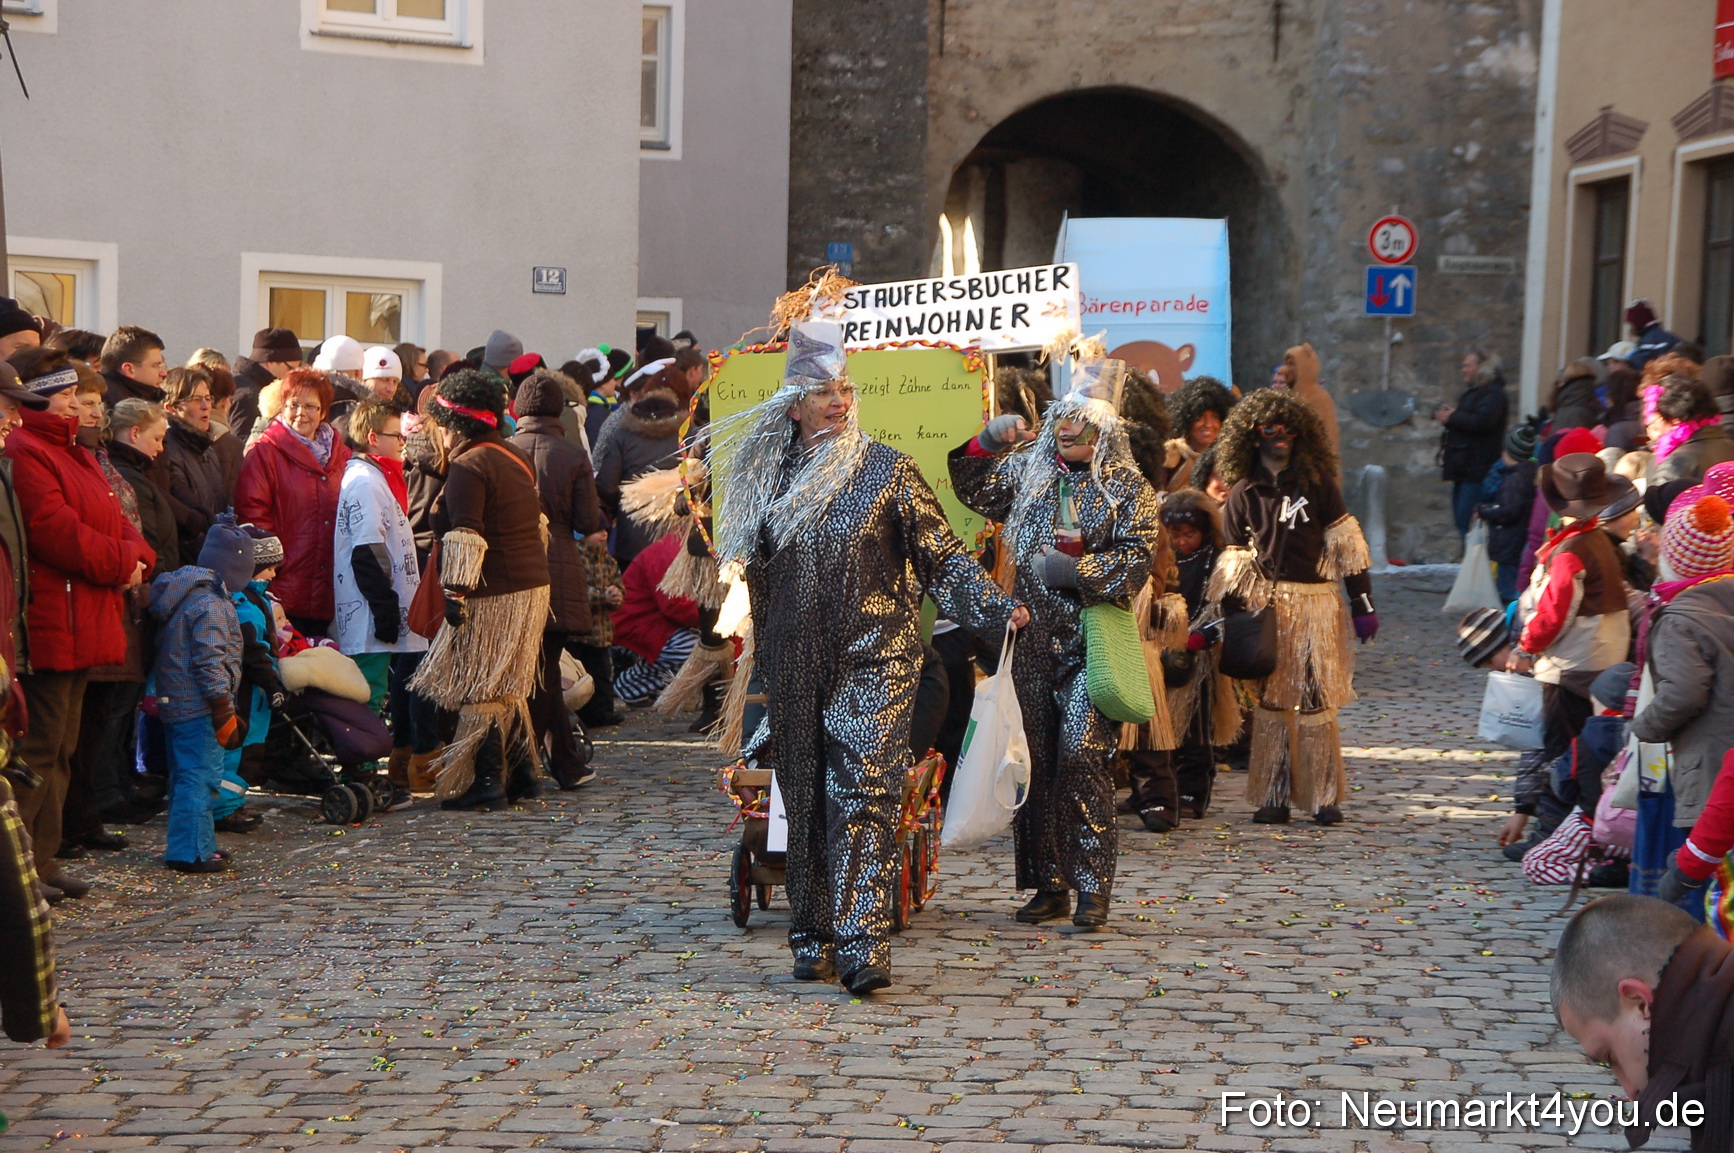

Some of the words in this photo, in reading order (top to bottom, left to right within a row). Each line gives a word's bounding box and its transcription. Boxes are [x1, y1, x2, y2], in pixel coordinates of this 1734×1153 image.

[1381, 230, 1391, 250] 3
[1393, 239, 1405, 250] m
[540, 269, 561, 283] 12
[843, 265, 1070, 310] STAUFERSBUCHER
[1079, 291, 1210, 317] Bärenparade
[841, 303, 1031, 344] REINWOHNER
[716, 379, 748, 401] Ein
[861, 376, 890, 397] zeigt
[898, 374, 932, 395] Zähne
[941, 376, 972, 391] dann
[868, 428, 903, 443] ißen
[916, 424, 949, 440] kann
